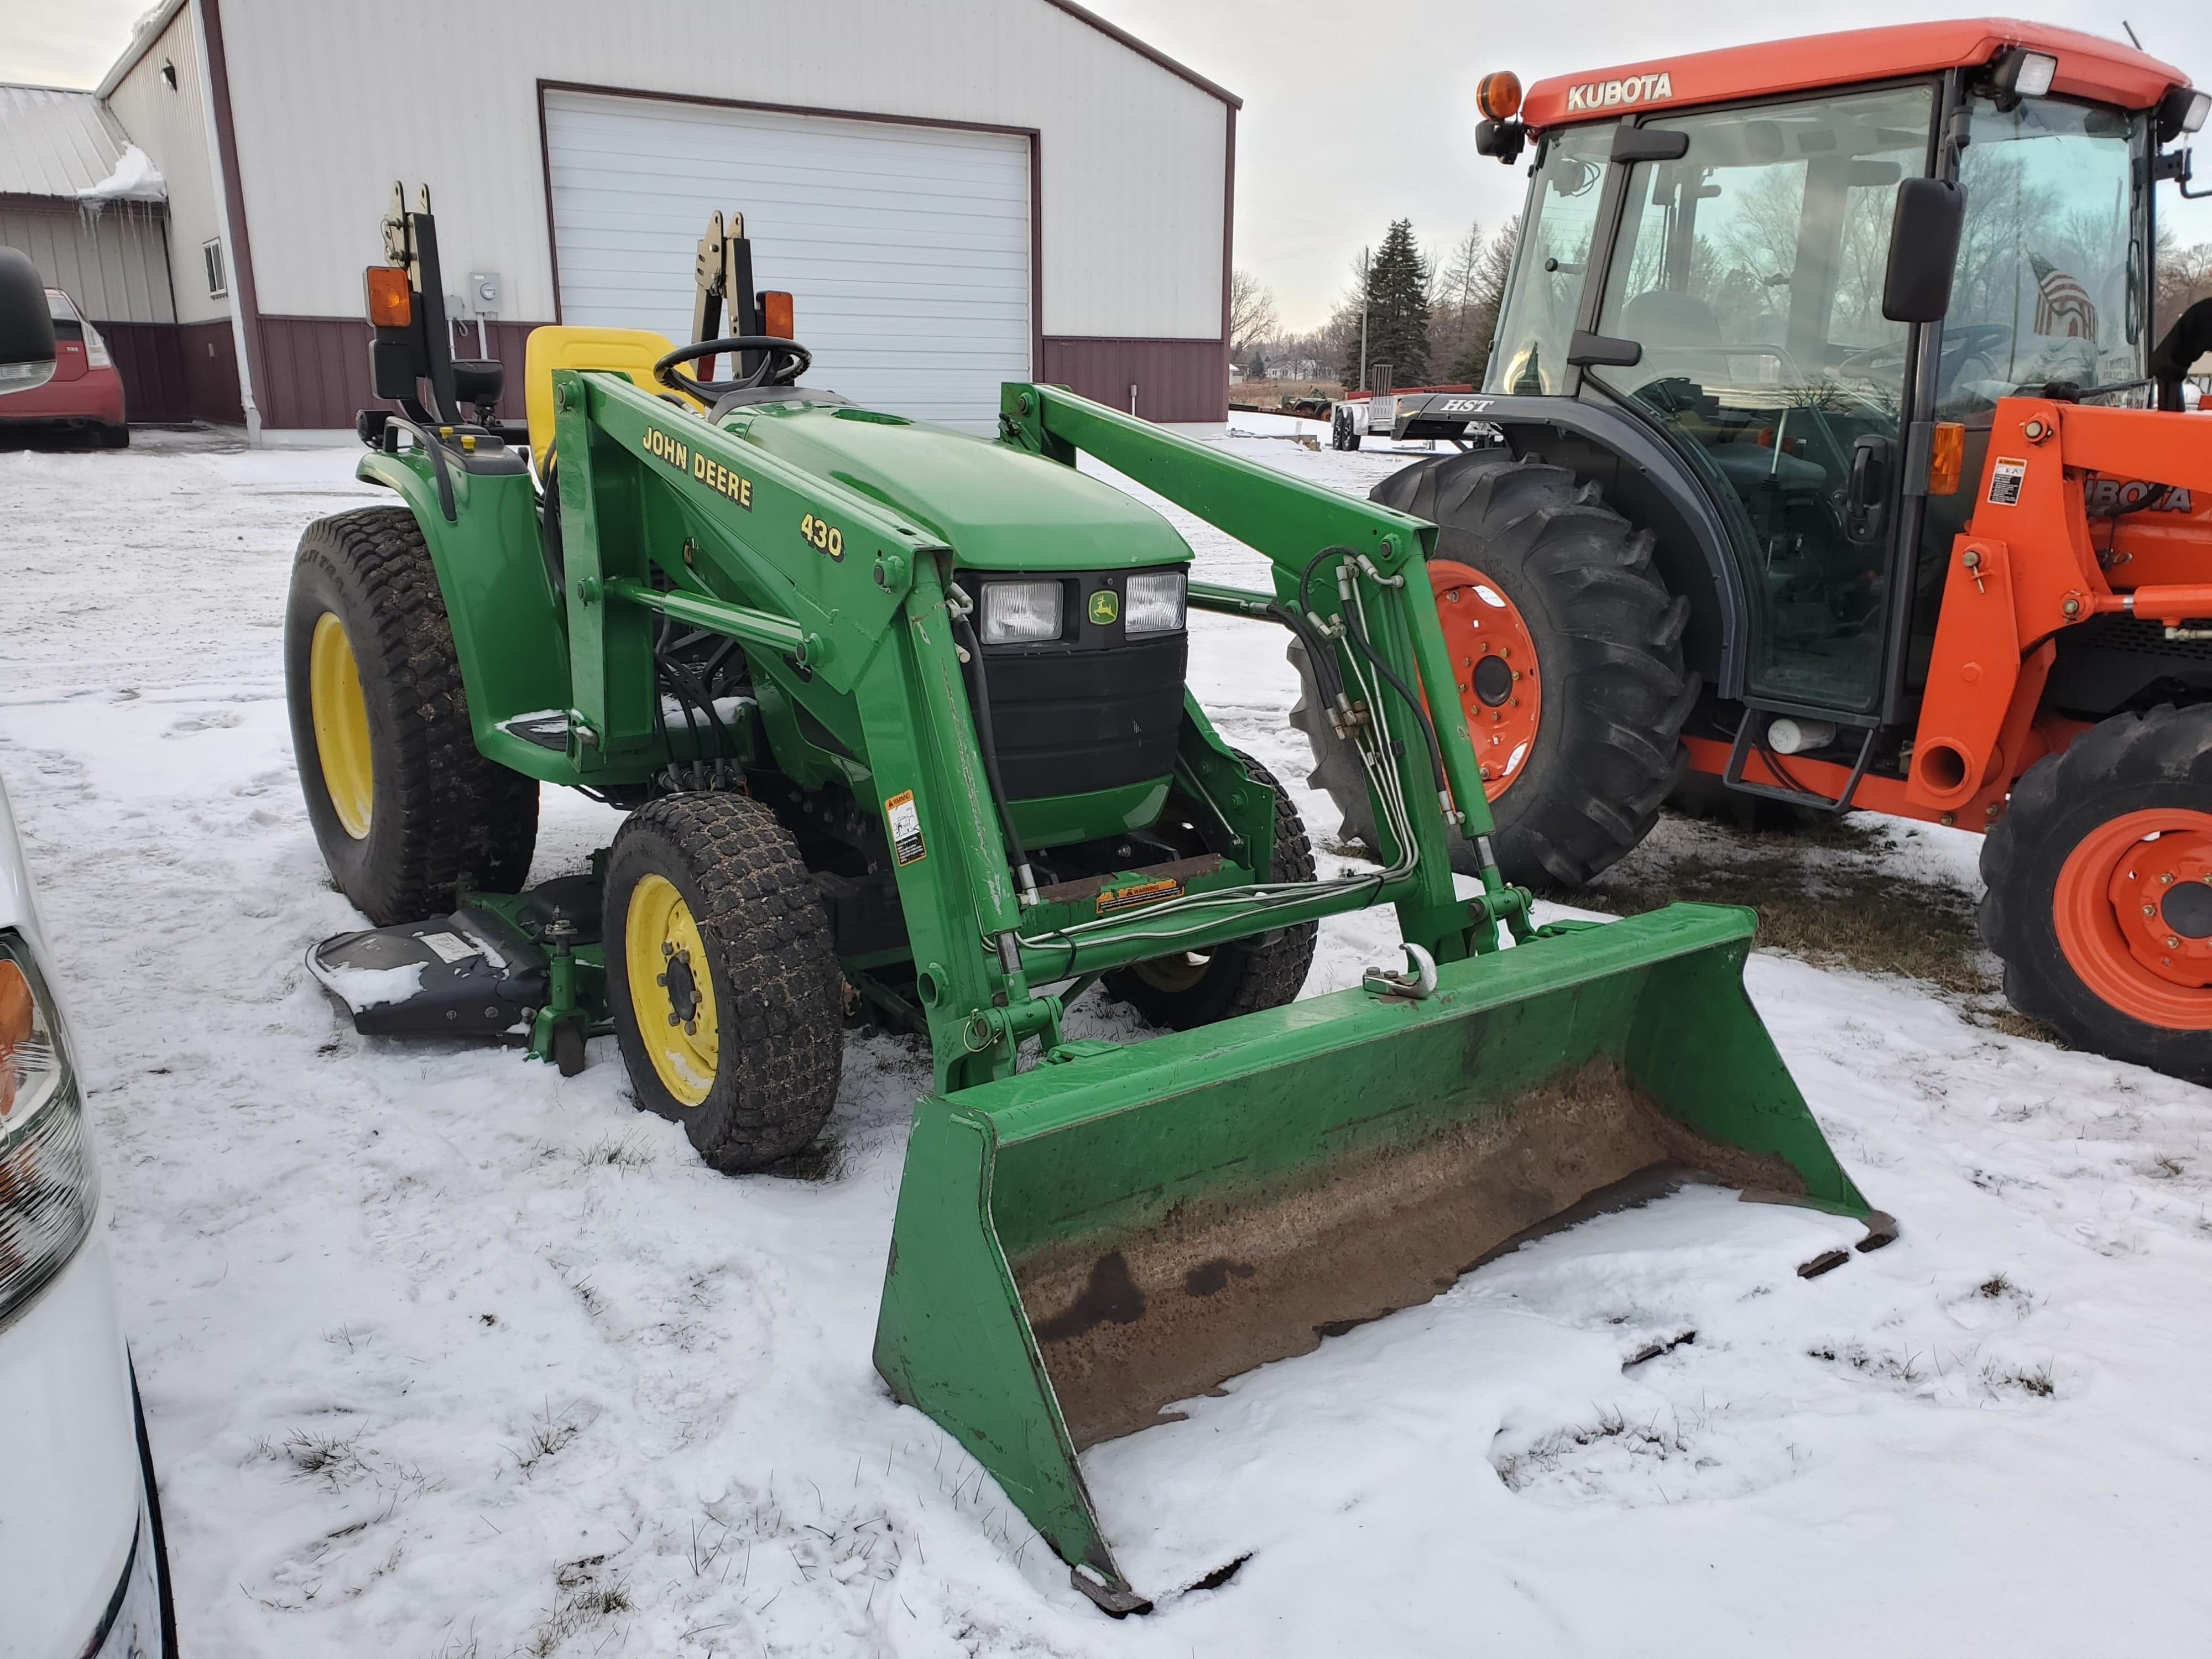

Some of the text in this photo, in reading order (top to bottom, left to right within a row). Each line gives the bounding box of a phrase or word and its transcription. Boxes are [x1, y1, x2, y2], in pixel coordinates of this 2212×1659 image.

[1568, 72, 1672, 111] KUBOTA
[1441, 399, 1495, 412] HST
[643, 425, 752, 510] JOHN DEERE
[801, 512, 844, 561] 430
[893, 792, 910, 806] WARNING
[1134, 885, 1159, 895] WARNING
